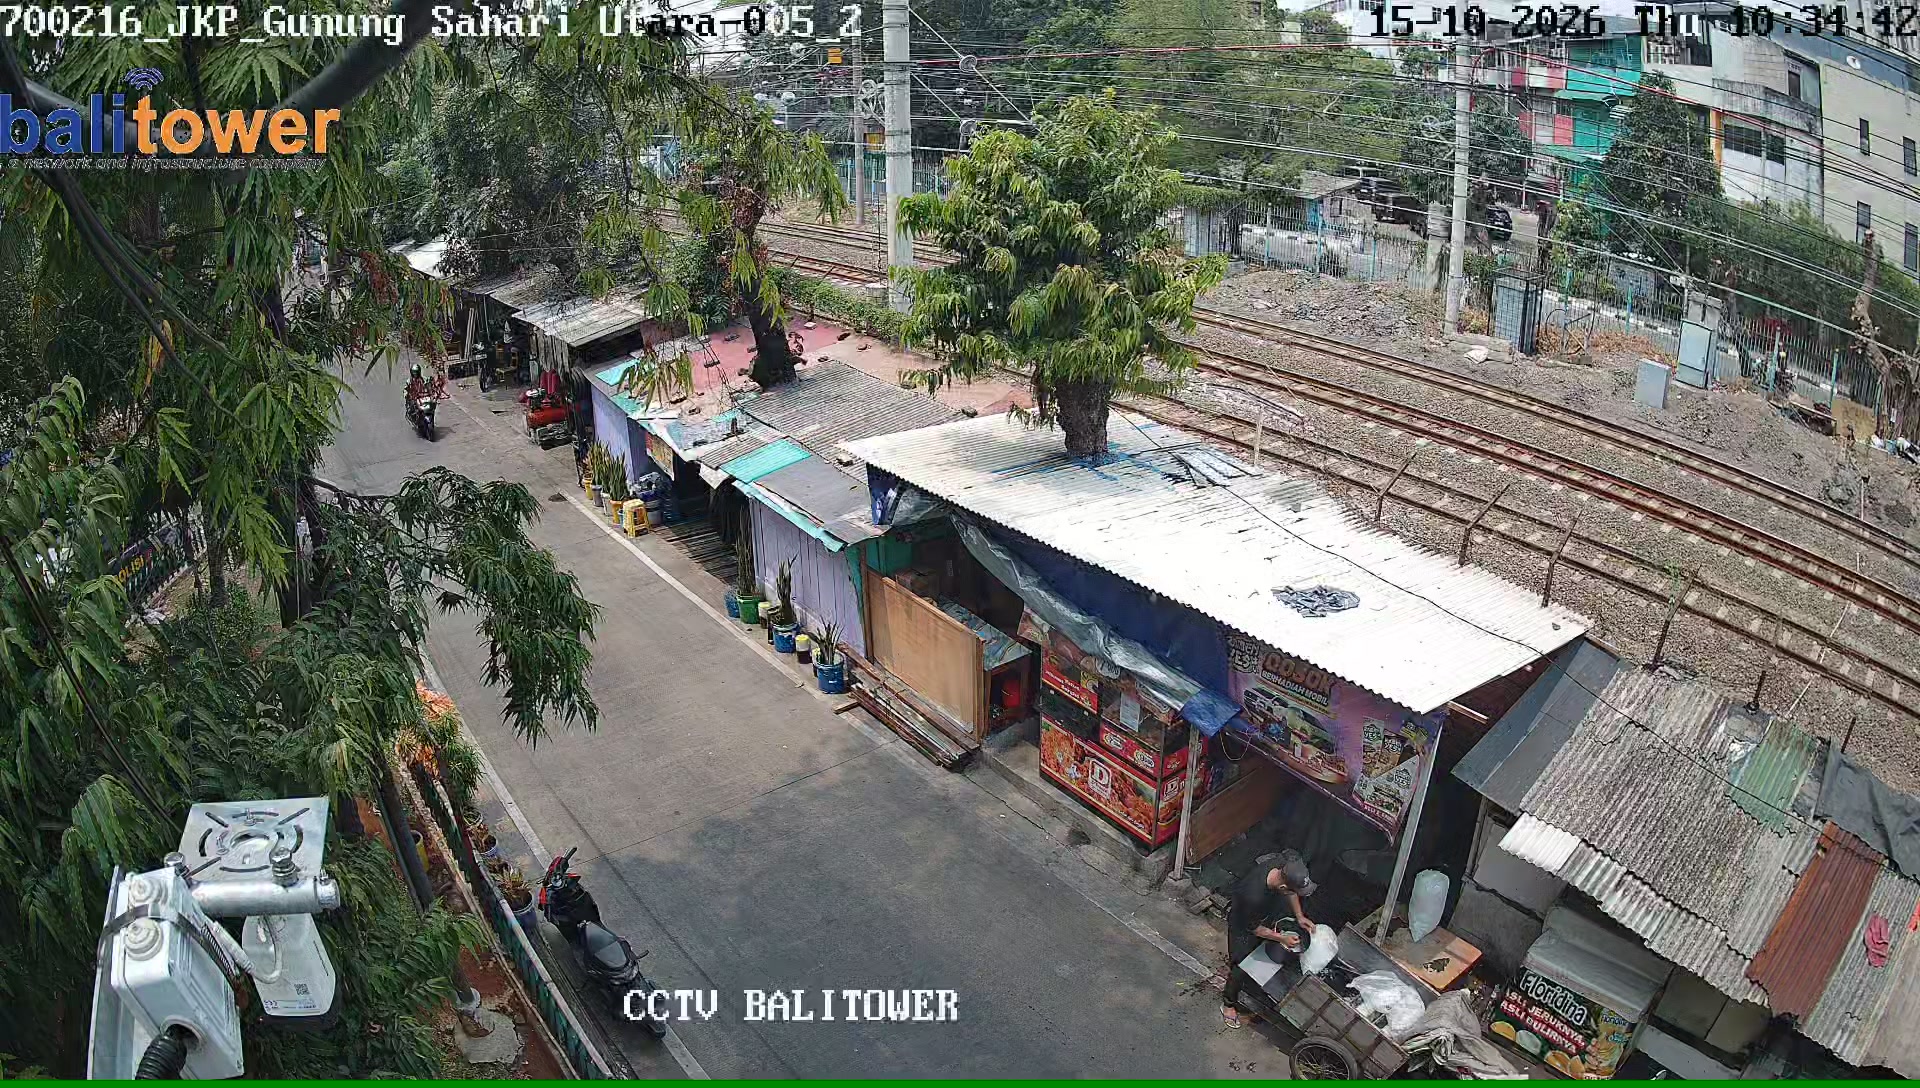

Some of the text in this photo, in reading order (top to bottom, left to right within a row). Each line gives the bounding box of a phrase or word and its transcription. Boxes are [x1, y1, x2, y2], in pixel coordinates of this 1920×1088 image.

[1262, 670, 1305, 694] BERHADIAH
[1305, 690, 1329, 706] MOBIL
[1520, 970, 1587, 1026] Floridina
[1500, 999, 1577, 1055] ASLI BULIRNYA
